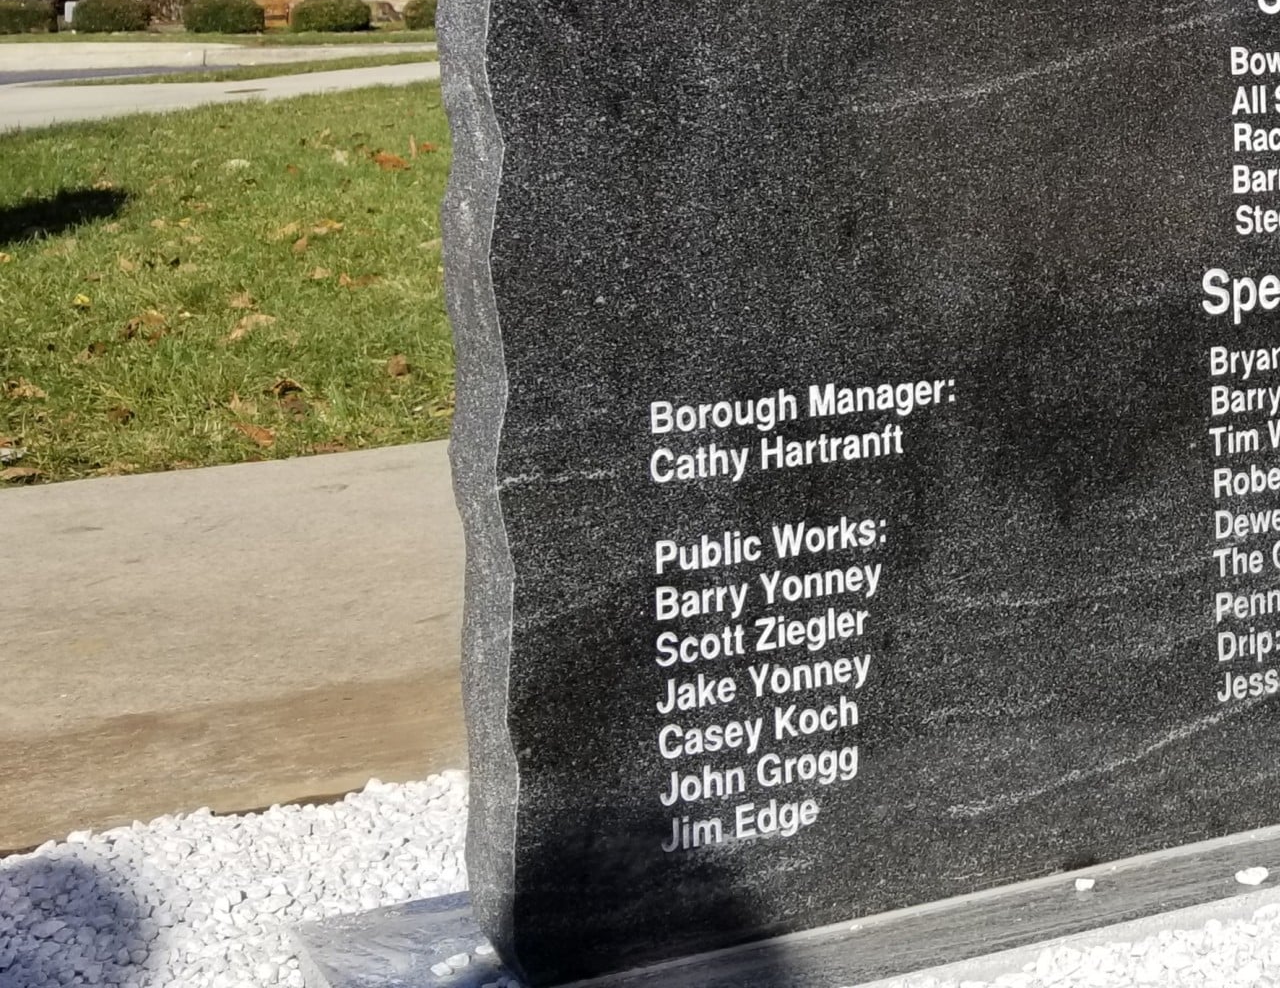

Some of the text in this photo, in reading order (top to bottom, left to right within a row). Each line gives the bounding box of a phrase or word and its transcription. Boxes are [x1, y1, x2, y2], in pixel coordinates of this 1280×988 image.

[1232, 85, 1266, 115] All
[651, 380, 955, 433] Borough Manager:
[650, 424, 903, 482] Cathy Hartranft
[1209, 426, 1258, 456] Tim
[656, 517, 886, 574] Public Works:
[1213, 547, 1263, 577] The
[656, 564, 881, 620] Barry Yonney
[656, 608, 869, 666] Scott Ziegler
[1218, 627, 1280, 662] Drip:
[657, 655, 870, 713] Jake Yonney
[659, 696, 858, 759] Casey Koch
[660, 746, 858, 805] John Grogg
[661, 799, 820, 853] Jim Edge
